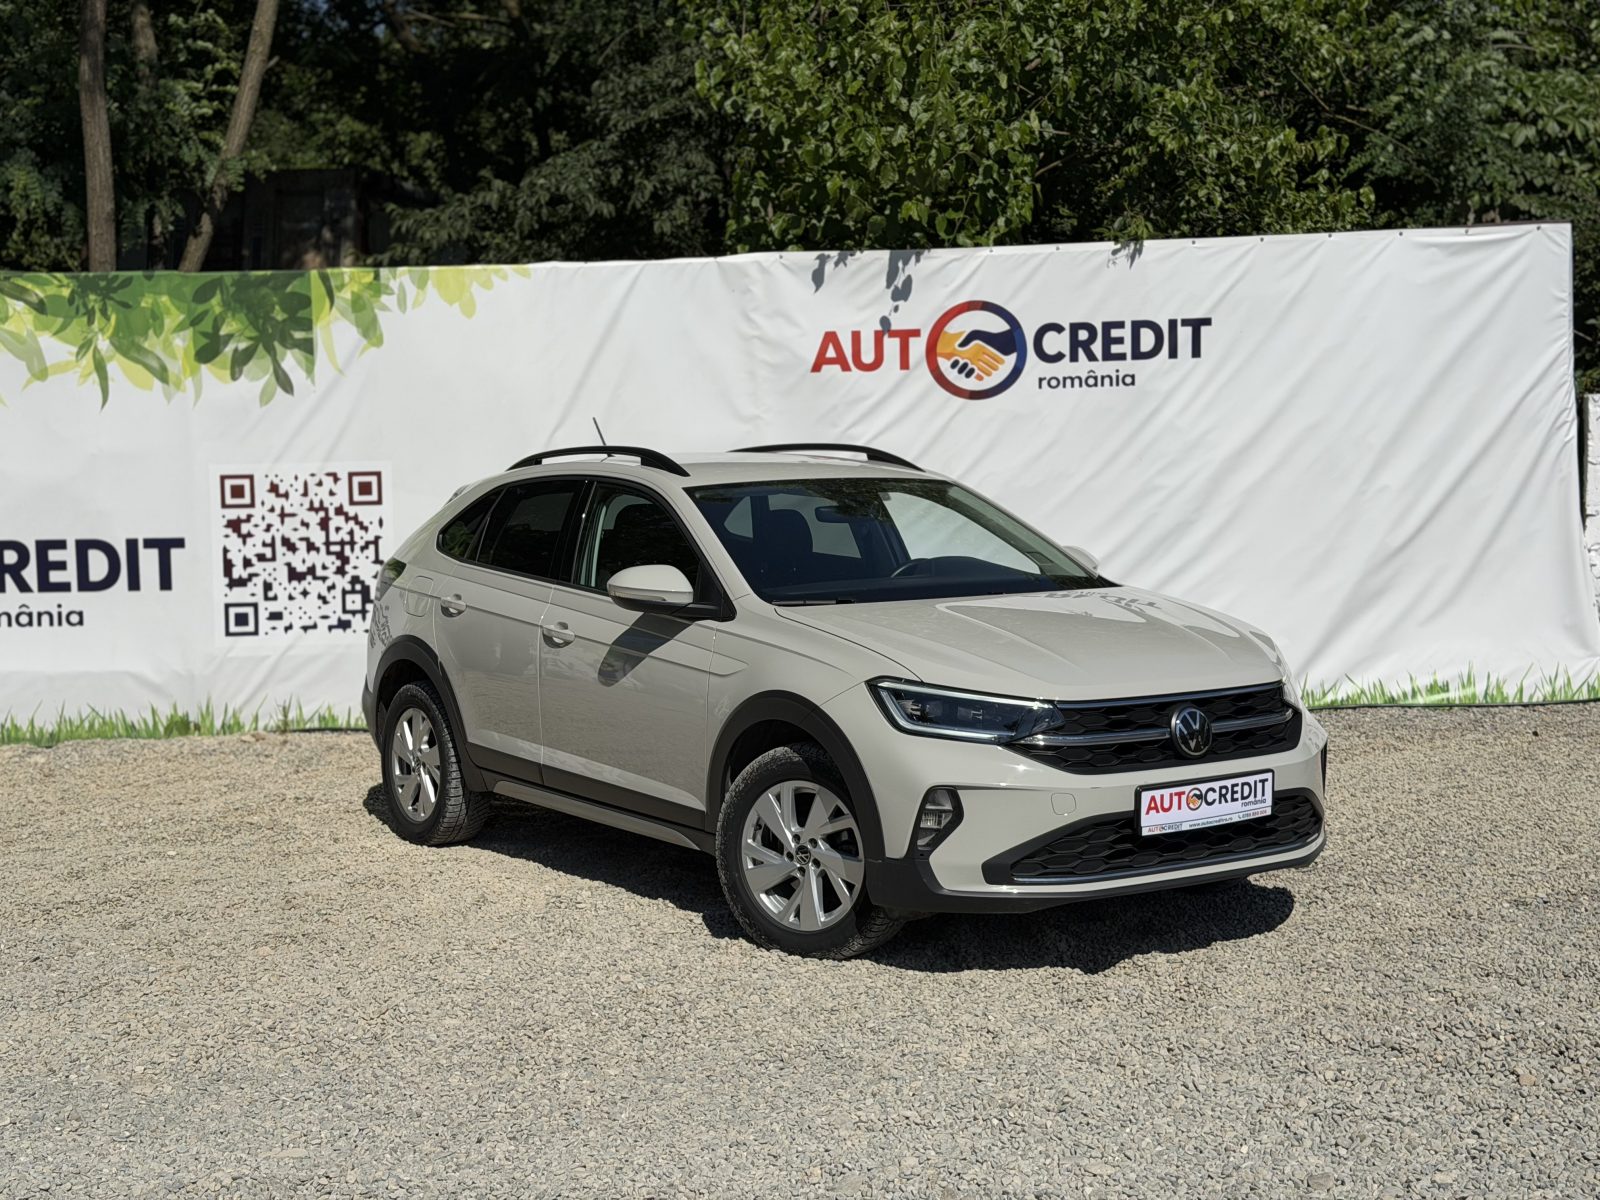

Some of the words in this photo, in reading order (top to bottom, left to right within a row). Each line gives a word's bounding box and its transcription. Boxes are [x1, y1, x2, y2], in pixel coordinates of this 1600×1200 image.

[1033, 317, 1213, 364] CREDIT
[1037, 369, 1136, 390] românia
[1241, 797, 1267, 808] românia
